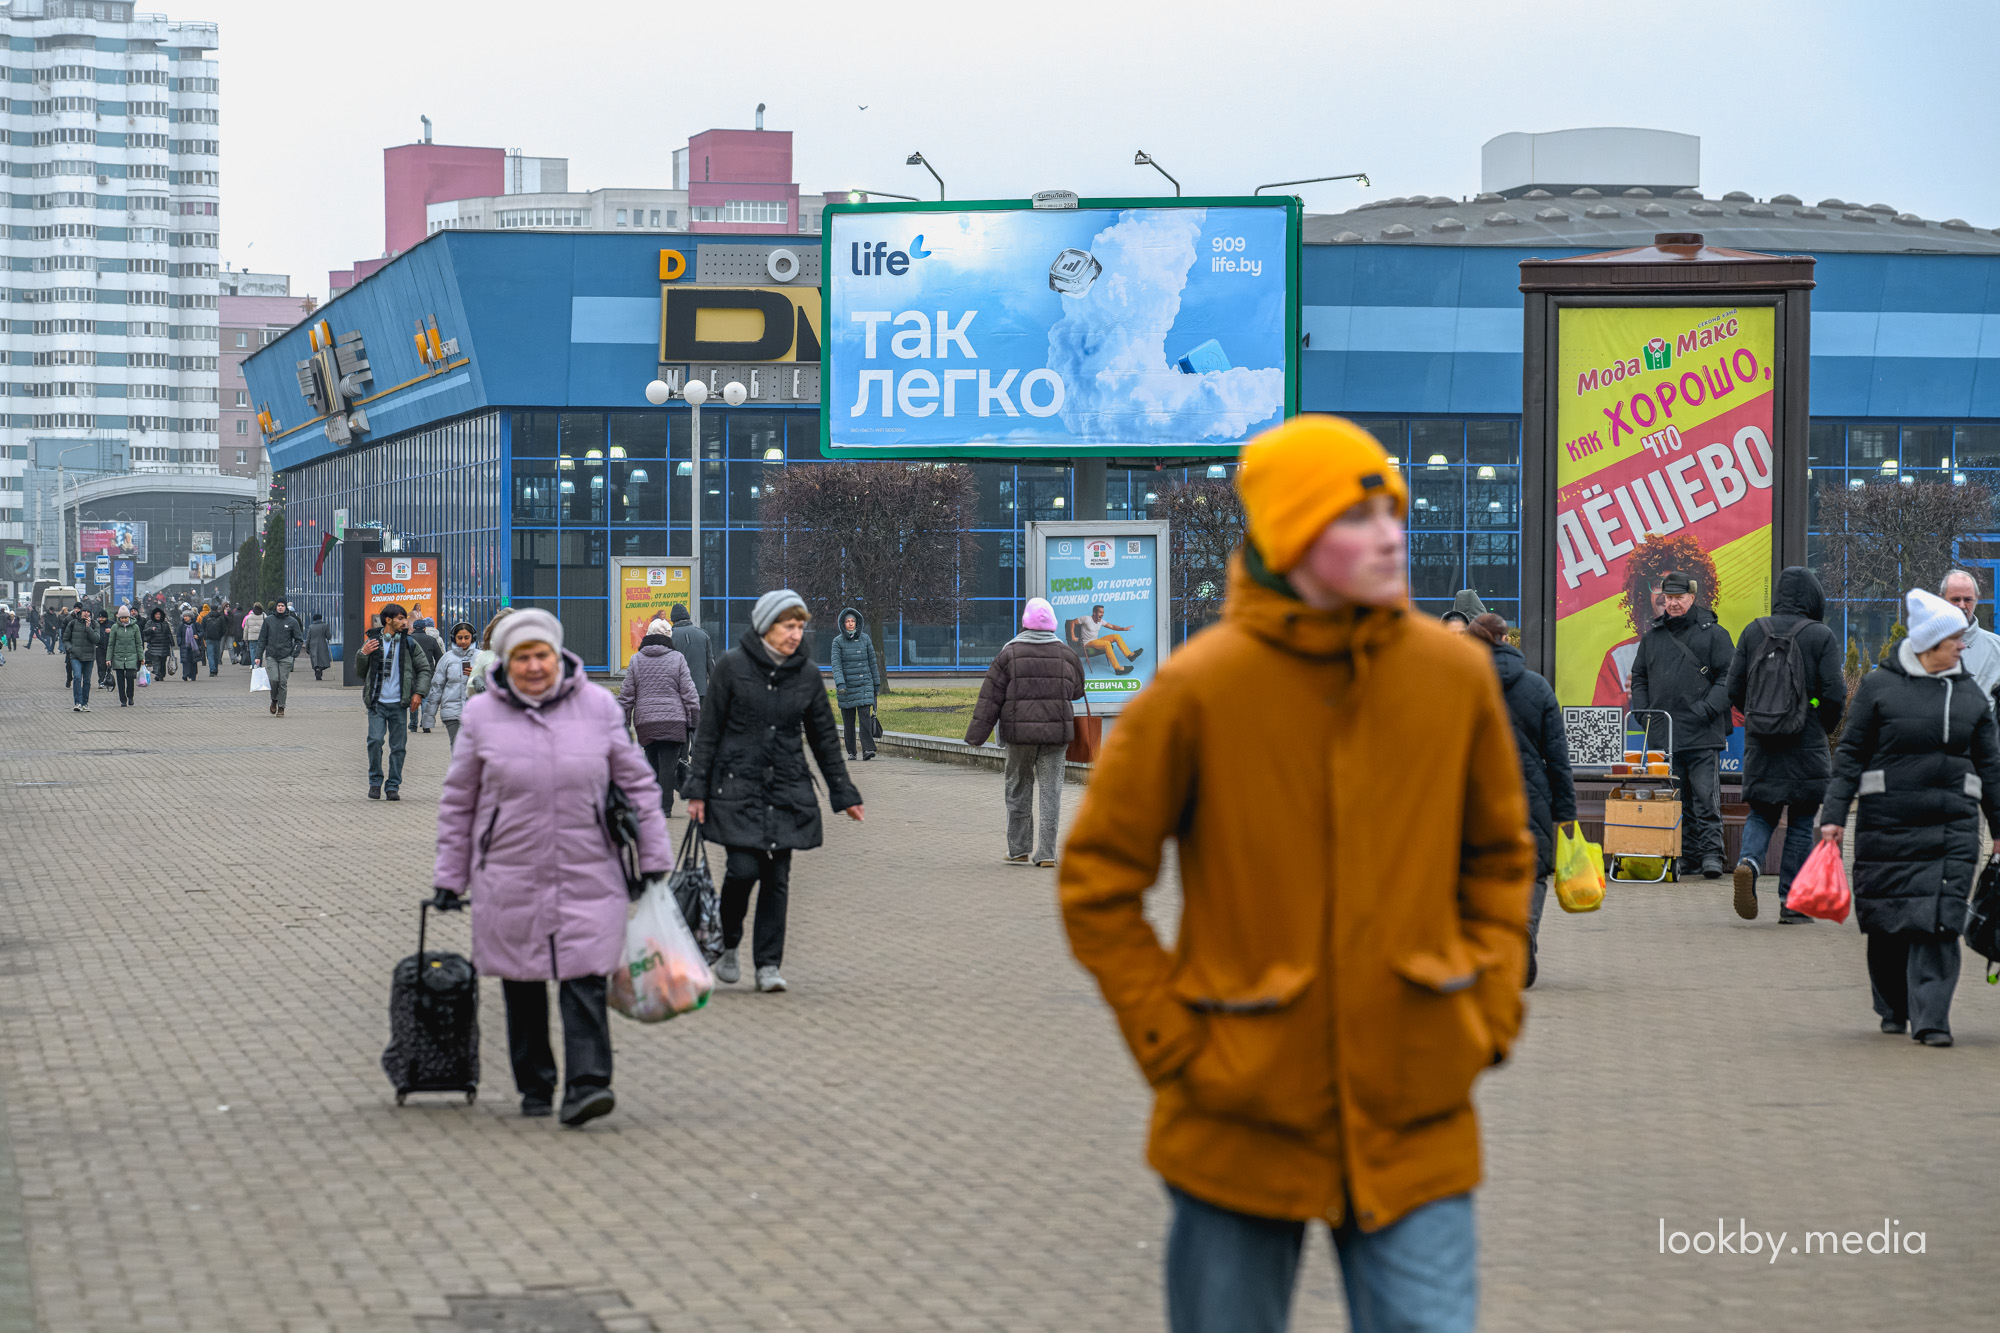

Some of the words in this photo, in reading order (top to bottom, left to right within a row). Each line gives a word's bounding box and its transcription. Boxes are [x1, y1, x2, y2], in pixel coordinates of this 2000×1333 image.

[1211, 236, 1246, 253] 909
[850, 241, 910, 276] life
[1211, 257, 1262, 277] life.by
[1698, 315, 1721, 328] СЕКОНД
[1722, 308, 1738, 319] ХЭНД
[851, 310, 978, 359] так
[1577, 357, 1641, 396] Мода
[1676, 318, 1739, 357] Макс
[850, 368, 1065, 418] легко
[1566, 430, 1604, 462] КАК
[1603, 348, 1772, 447] ХОРОШО,
[1641, 424, 1683, 459] ЧТО
[1557, 425, 1773, 590] ДЁШЕВО
[371, 583, 406, 594] КРОВАТЬ
[1097, 580, 1107, 589] ОТ
[1110, 577, 1152, 588] КОТОРОГО
[625, 601, 650, 609] СЛОЖНО
[1051, 593, 1090, 606] СЛОЖНО
[1091, 590, 1150, 603] ОТОРВАТЬСЯ!
[1126, 681, 1138, 689] 35
